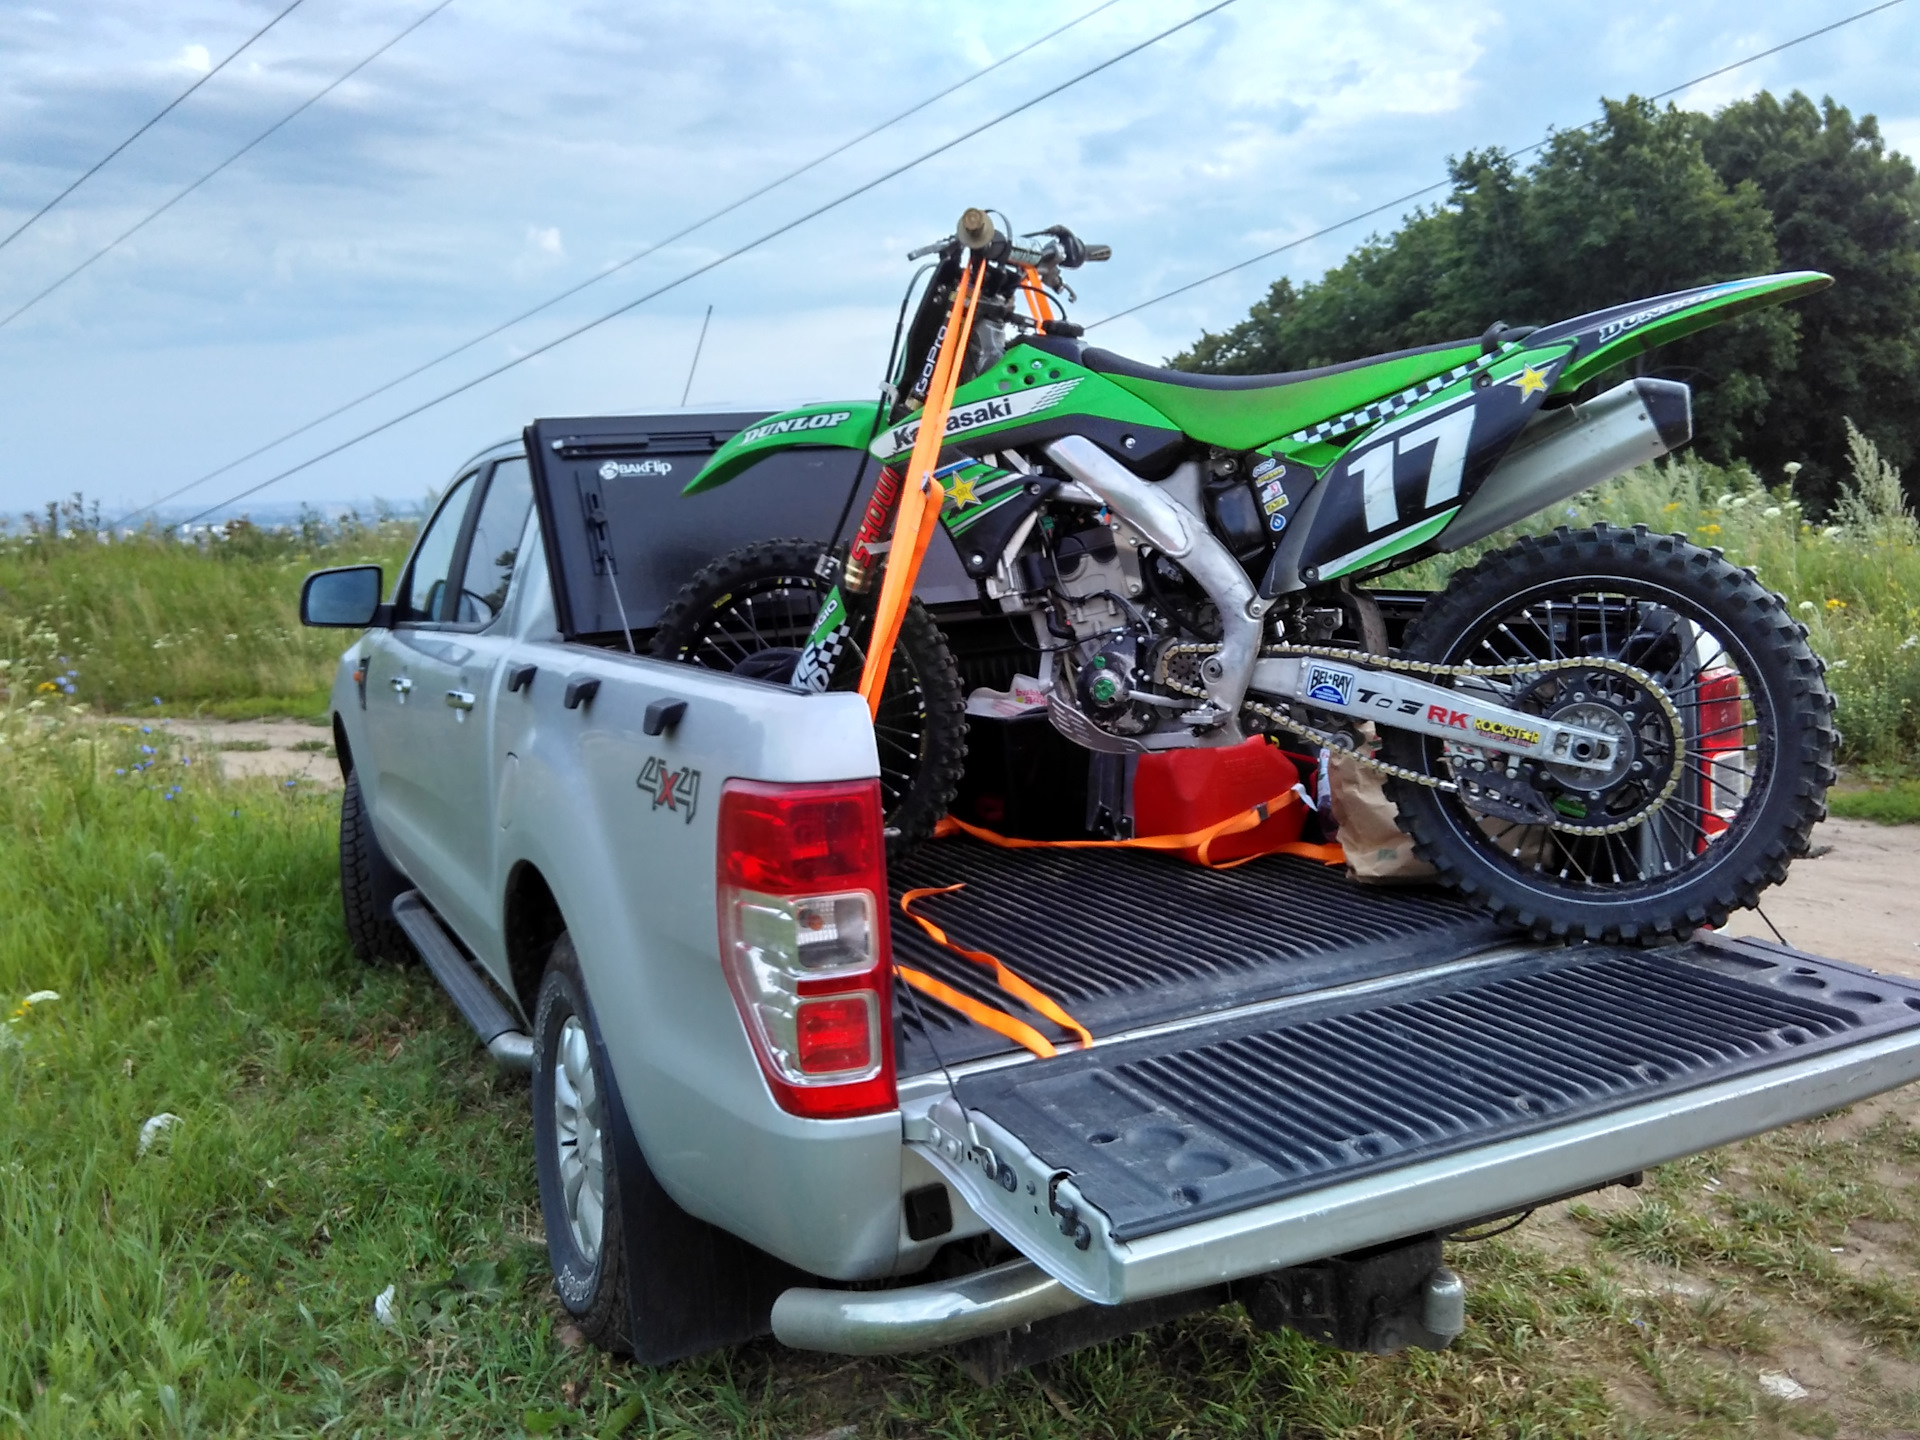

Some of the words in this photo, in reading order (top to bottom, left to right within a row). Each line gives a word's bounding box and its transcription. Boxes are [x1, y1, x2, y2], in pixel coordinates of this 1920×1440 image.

[740, 412, 850, 447] DUNLOP
[893, 398, 1012, 450] Kaasaki
[1347, 404, 1477, 533] 17
[852, 466, 901, 568] SHOW
[1427, 704, 1469, 729] RK
